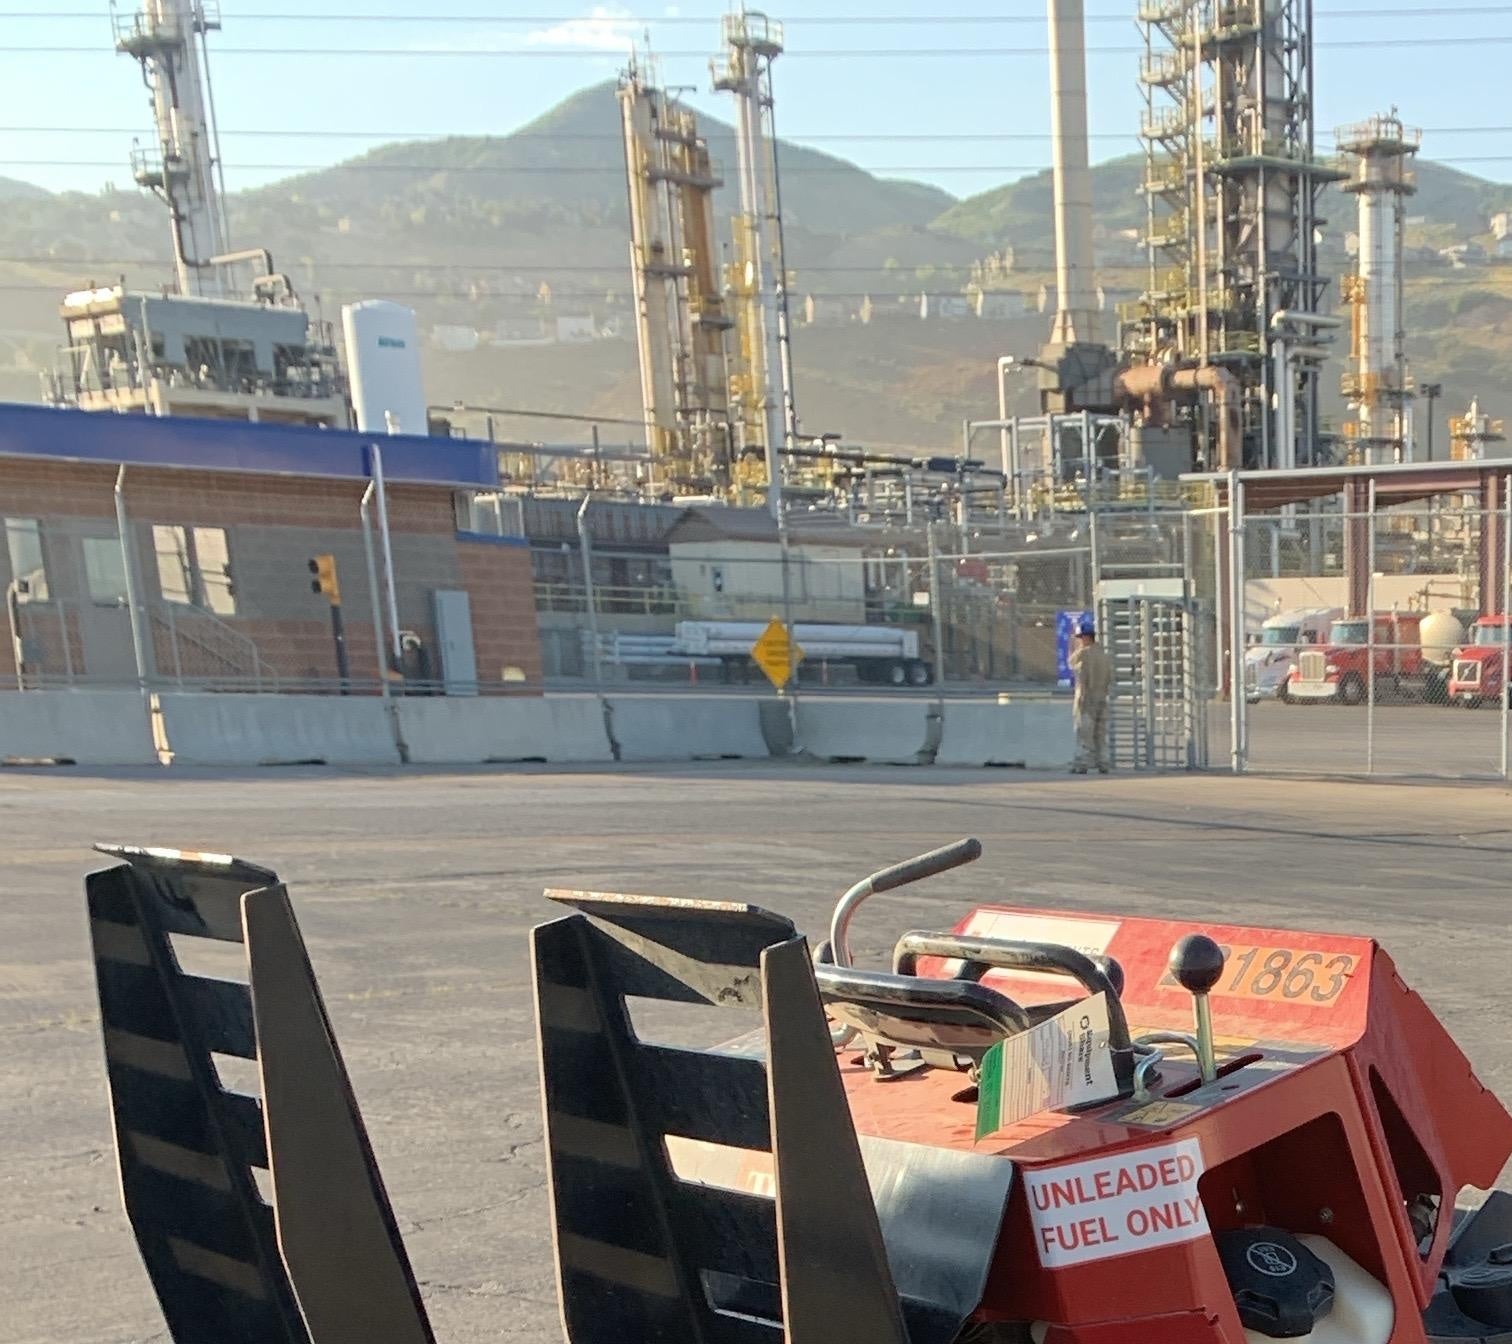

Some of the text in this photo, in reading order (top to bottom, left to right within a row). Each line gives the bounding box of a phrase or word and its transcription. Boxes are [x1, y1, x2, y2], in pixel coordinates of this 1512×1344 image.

[1159, 945, 1353, 1002] 1863
[1031, 1155, 1196, 1211] UNLEADED
[1040, 1196, 1200, 1255] FUEL ONLY
